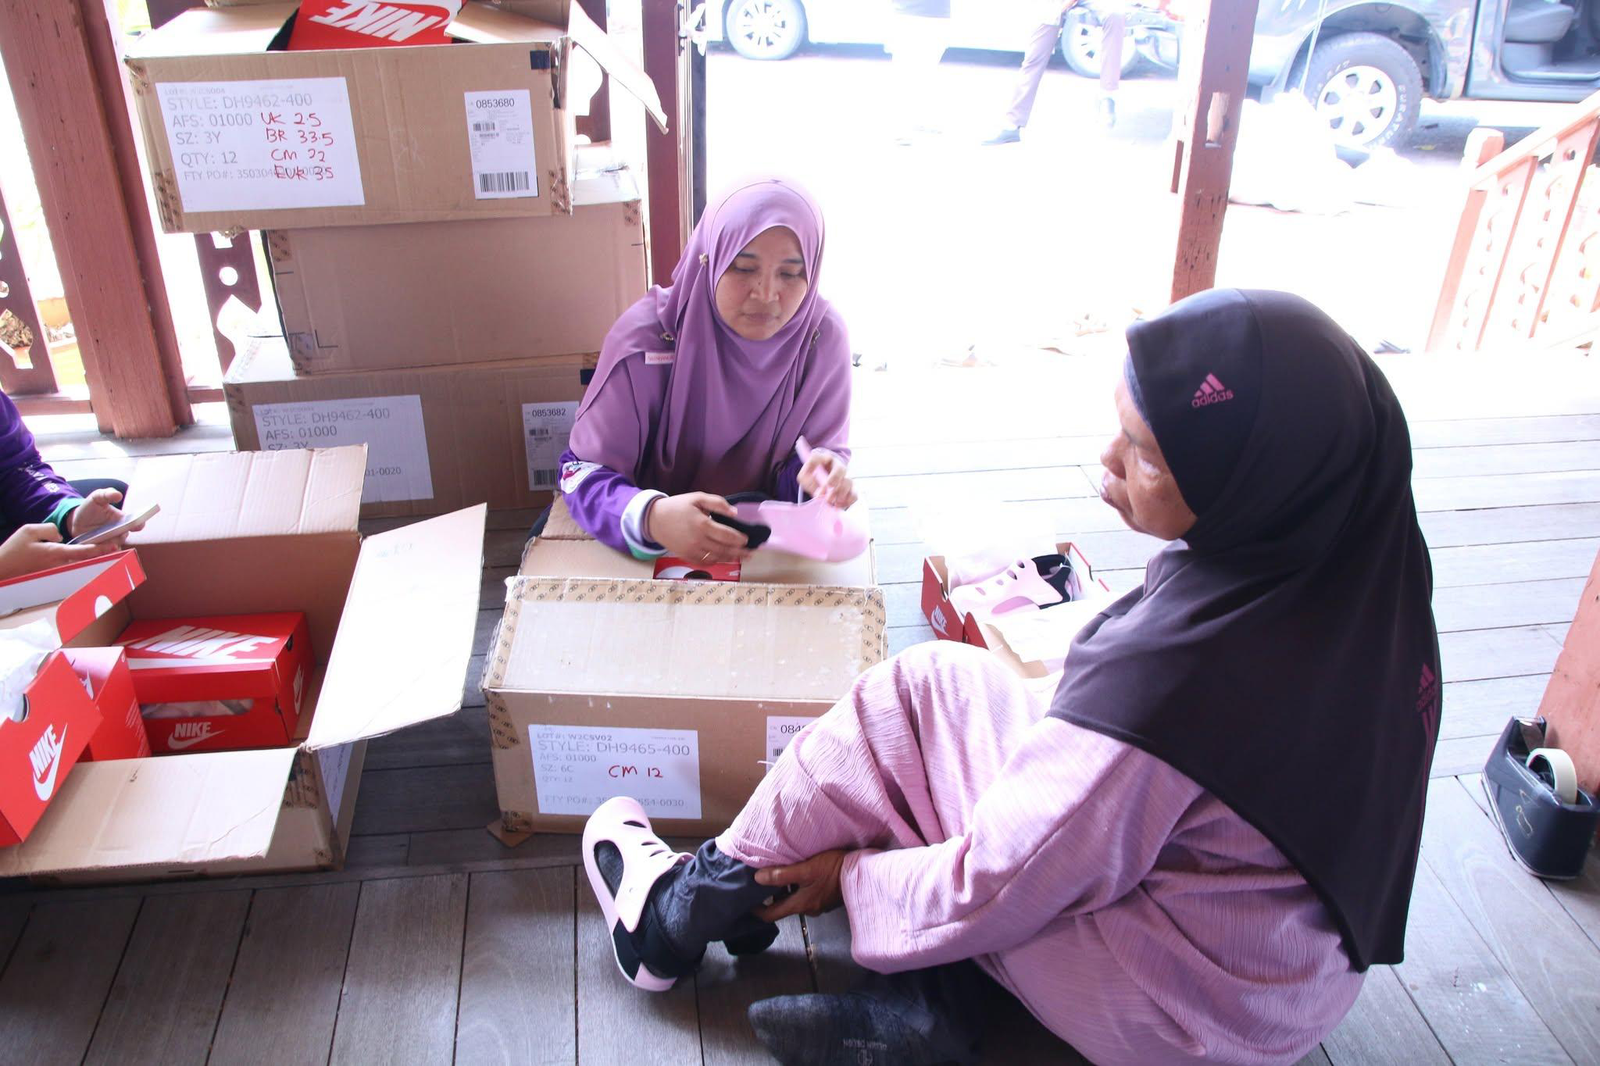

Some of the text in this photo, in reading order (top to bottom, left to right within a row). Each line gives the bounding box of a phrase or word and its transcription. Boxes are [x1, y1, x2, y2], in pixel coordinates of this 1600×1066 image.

[308, 0, 442, 42] NIKE
[167, 93, 313, 111] STYLE: DH9462-400
[475, 98, 515, 109] 0853680
[173, 113, 253, 128] AFS: 01000
[260, 112, 321, 127] UK 2.5
[175, 130, 221, 145] SZ: 3Y
[266, 128, 334, 146] BR 33.5
[181, 150, 239, 168] QTY: 12
[270, 149, 298, 162] CM
[184, 170, 203, 181] FTY
[1191, 389, 1235, 408] adidas
[262, 413, 308, 428] STYLE:
[311, 407, 391, 424] DH9462-400
[531, 407, 567, 418] 0853682
[265, 424, 338, 441] AFS: 01000
[127, 625, 279, 659] NIKE
[174, 721, 213, 739] NIKE
[28, 723, 61, 780] NIKE
[538, 740, 690, 756] STYLE: DH9465-400
[565, 753, 597, 763] 01000
[541, 763, 575, 773] SZ: 6C
[608, 764, 664, 778] CM 12
